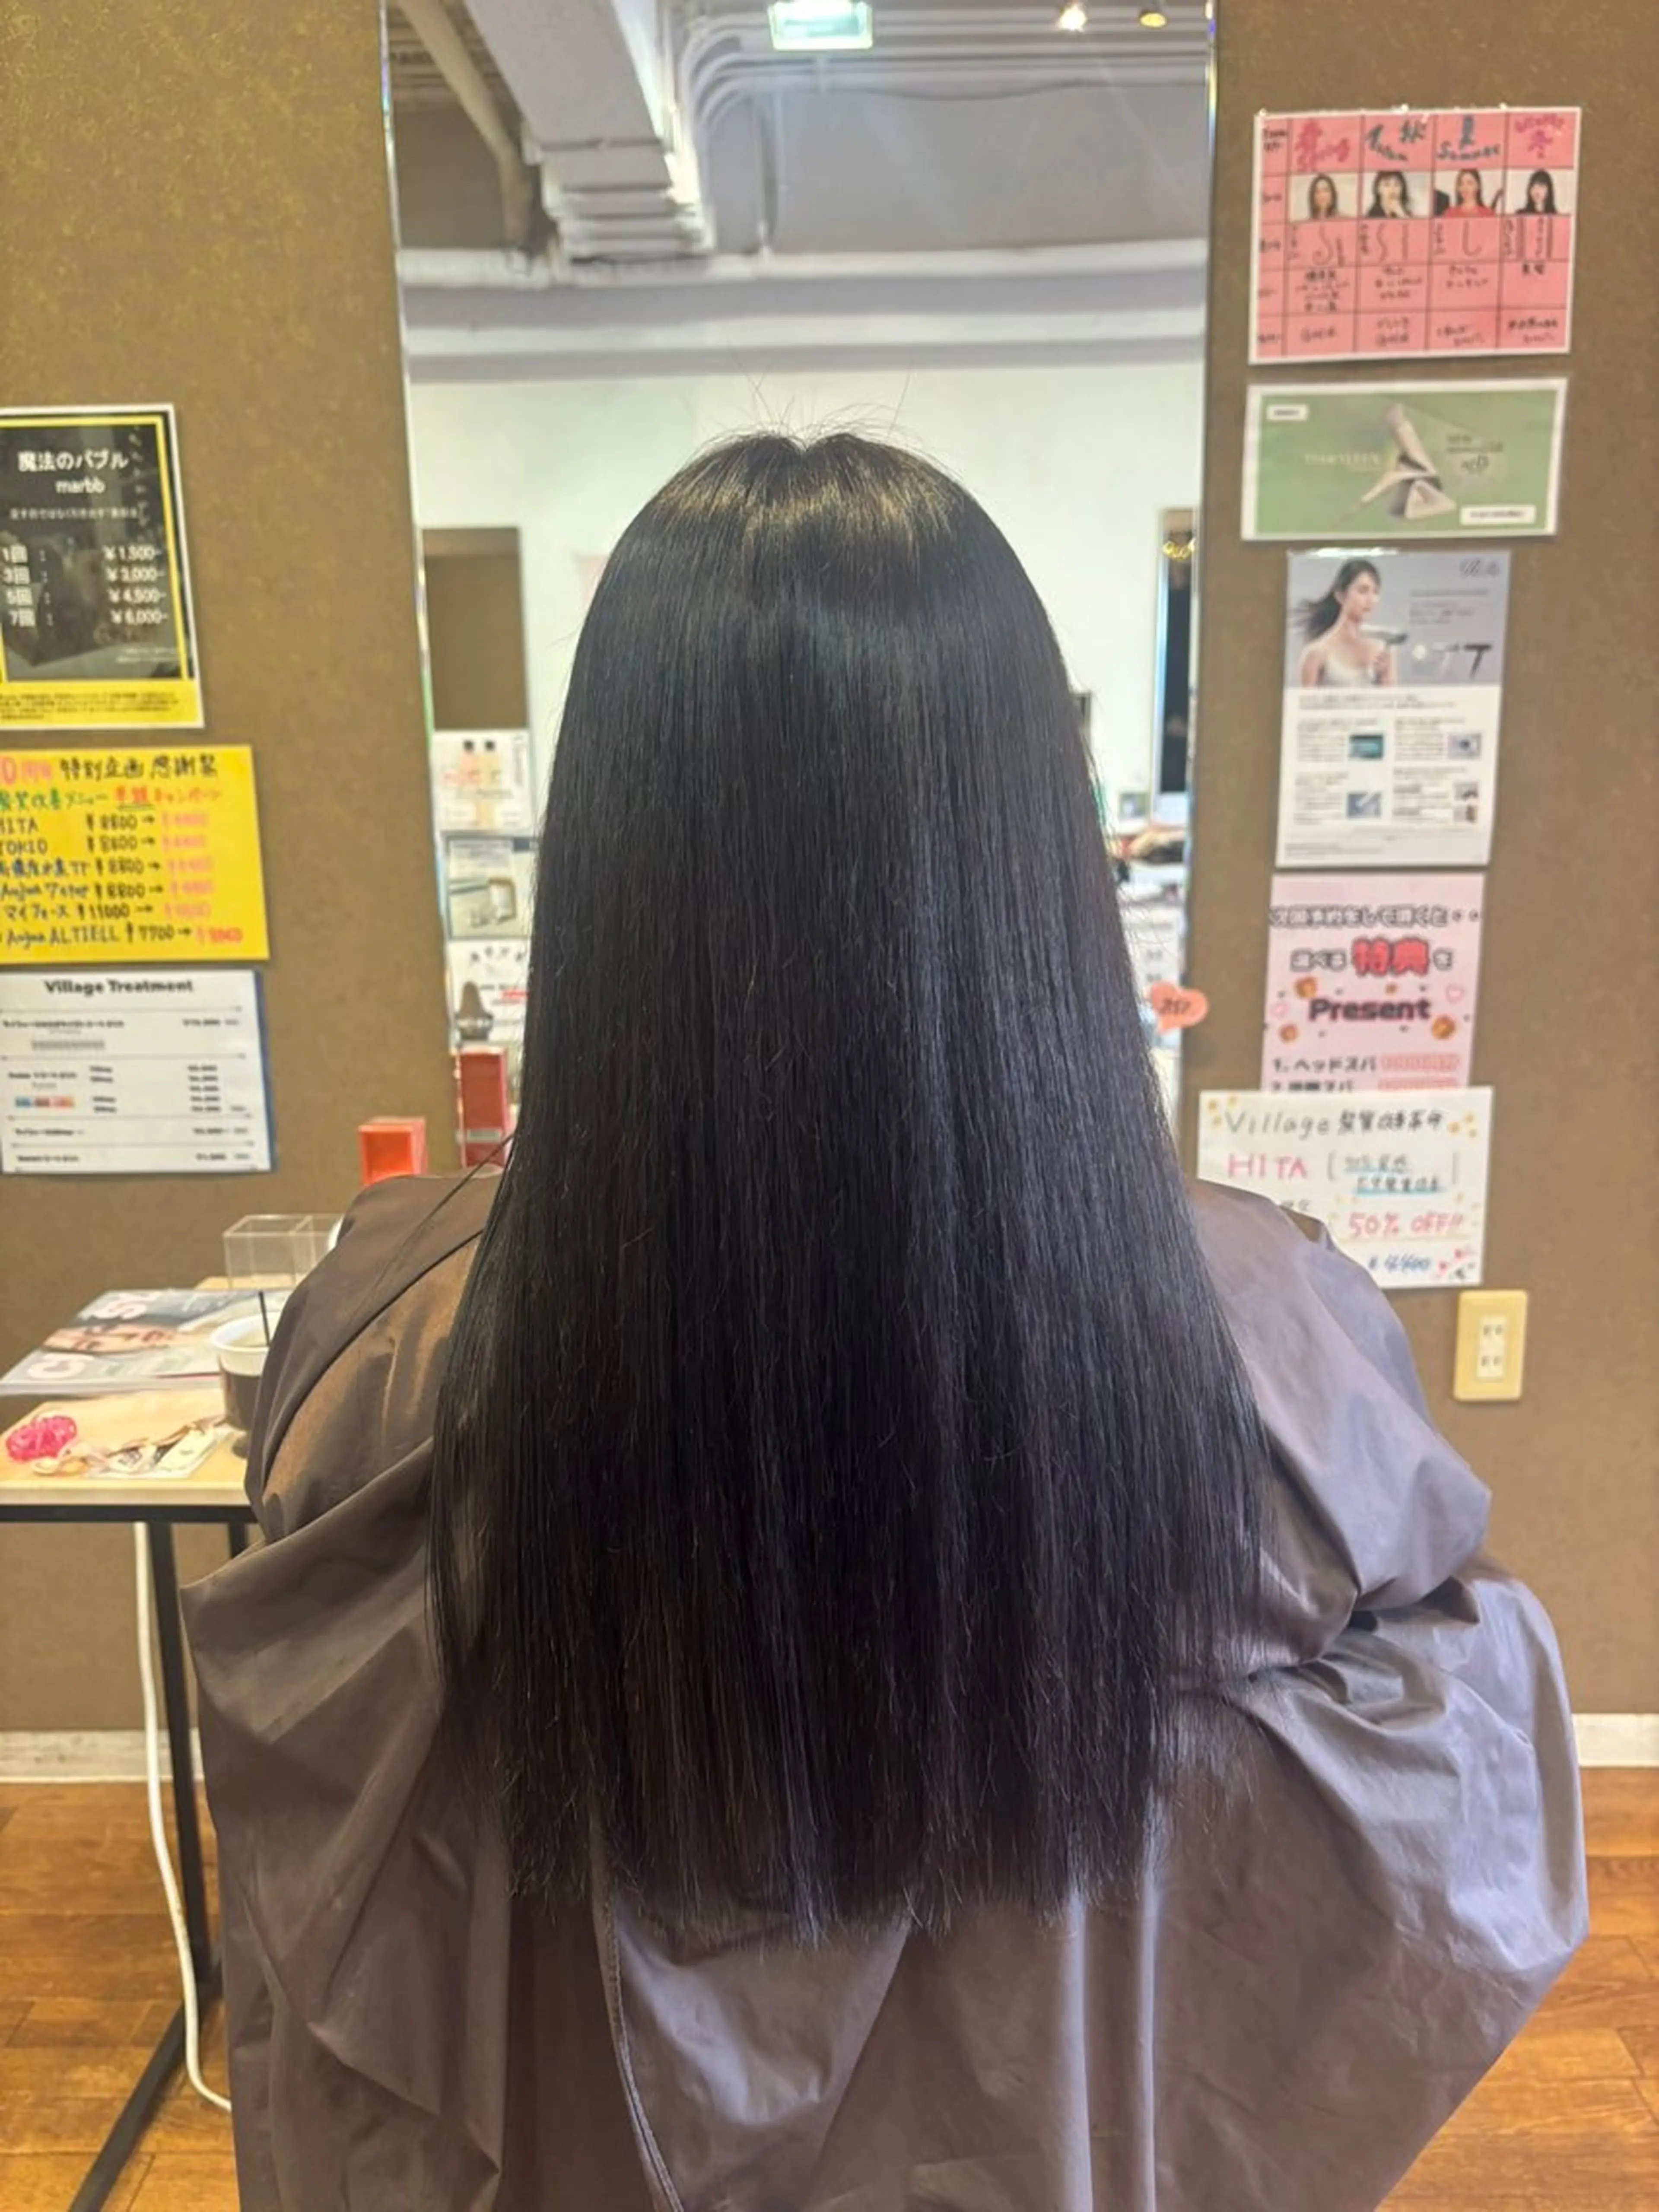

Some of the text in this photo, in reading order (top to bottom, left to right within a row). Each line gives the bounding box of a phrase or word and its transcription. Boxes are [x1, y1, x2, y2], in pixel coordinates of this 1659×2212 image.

[17, 448, 129, 473] 魔法のバブル
[44, 979, 193, 996] Village Treatment
[1309, 998, 1432, 1021] Present
[1225, 1111, 1329, 1140] Village
[1227, 1154, 1308, 1179] HITA
[1348, 1212, 1399, 1238] 50%
